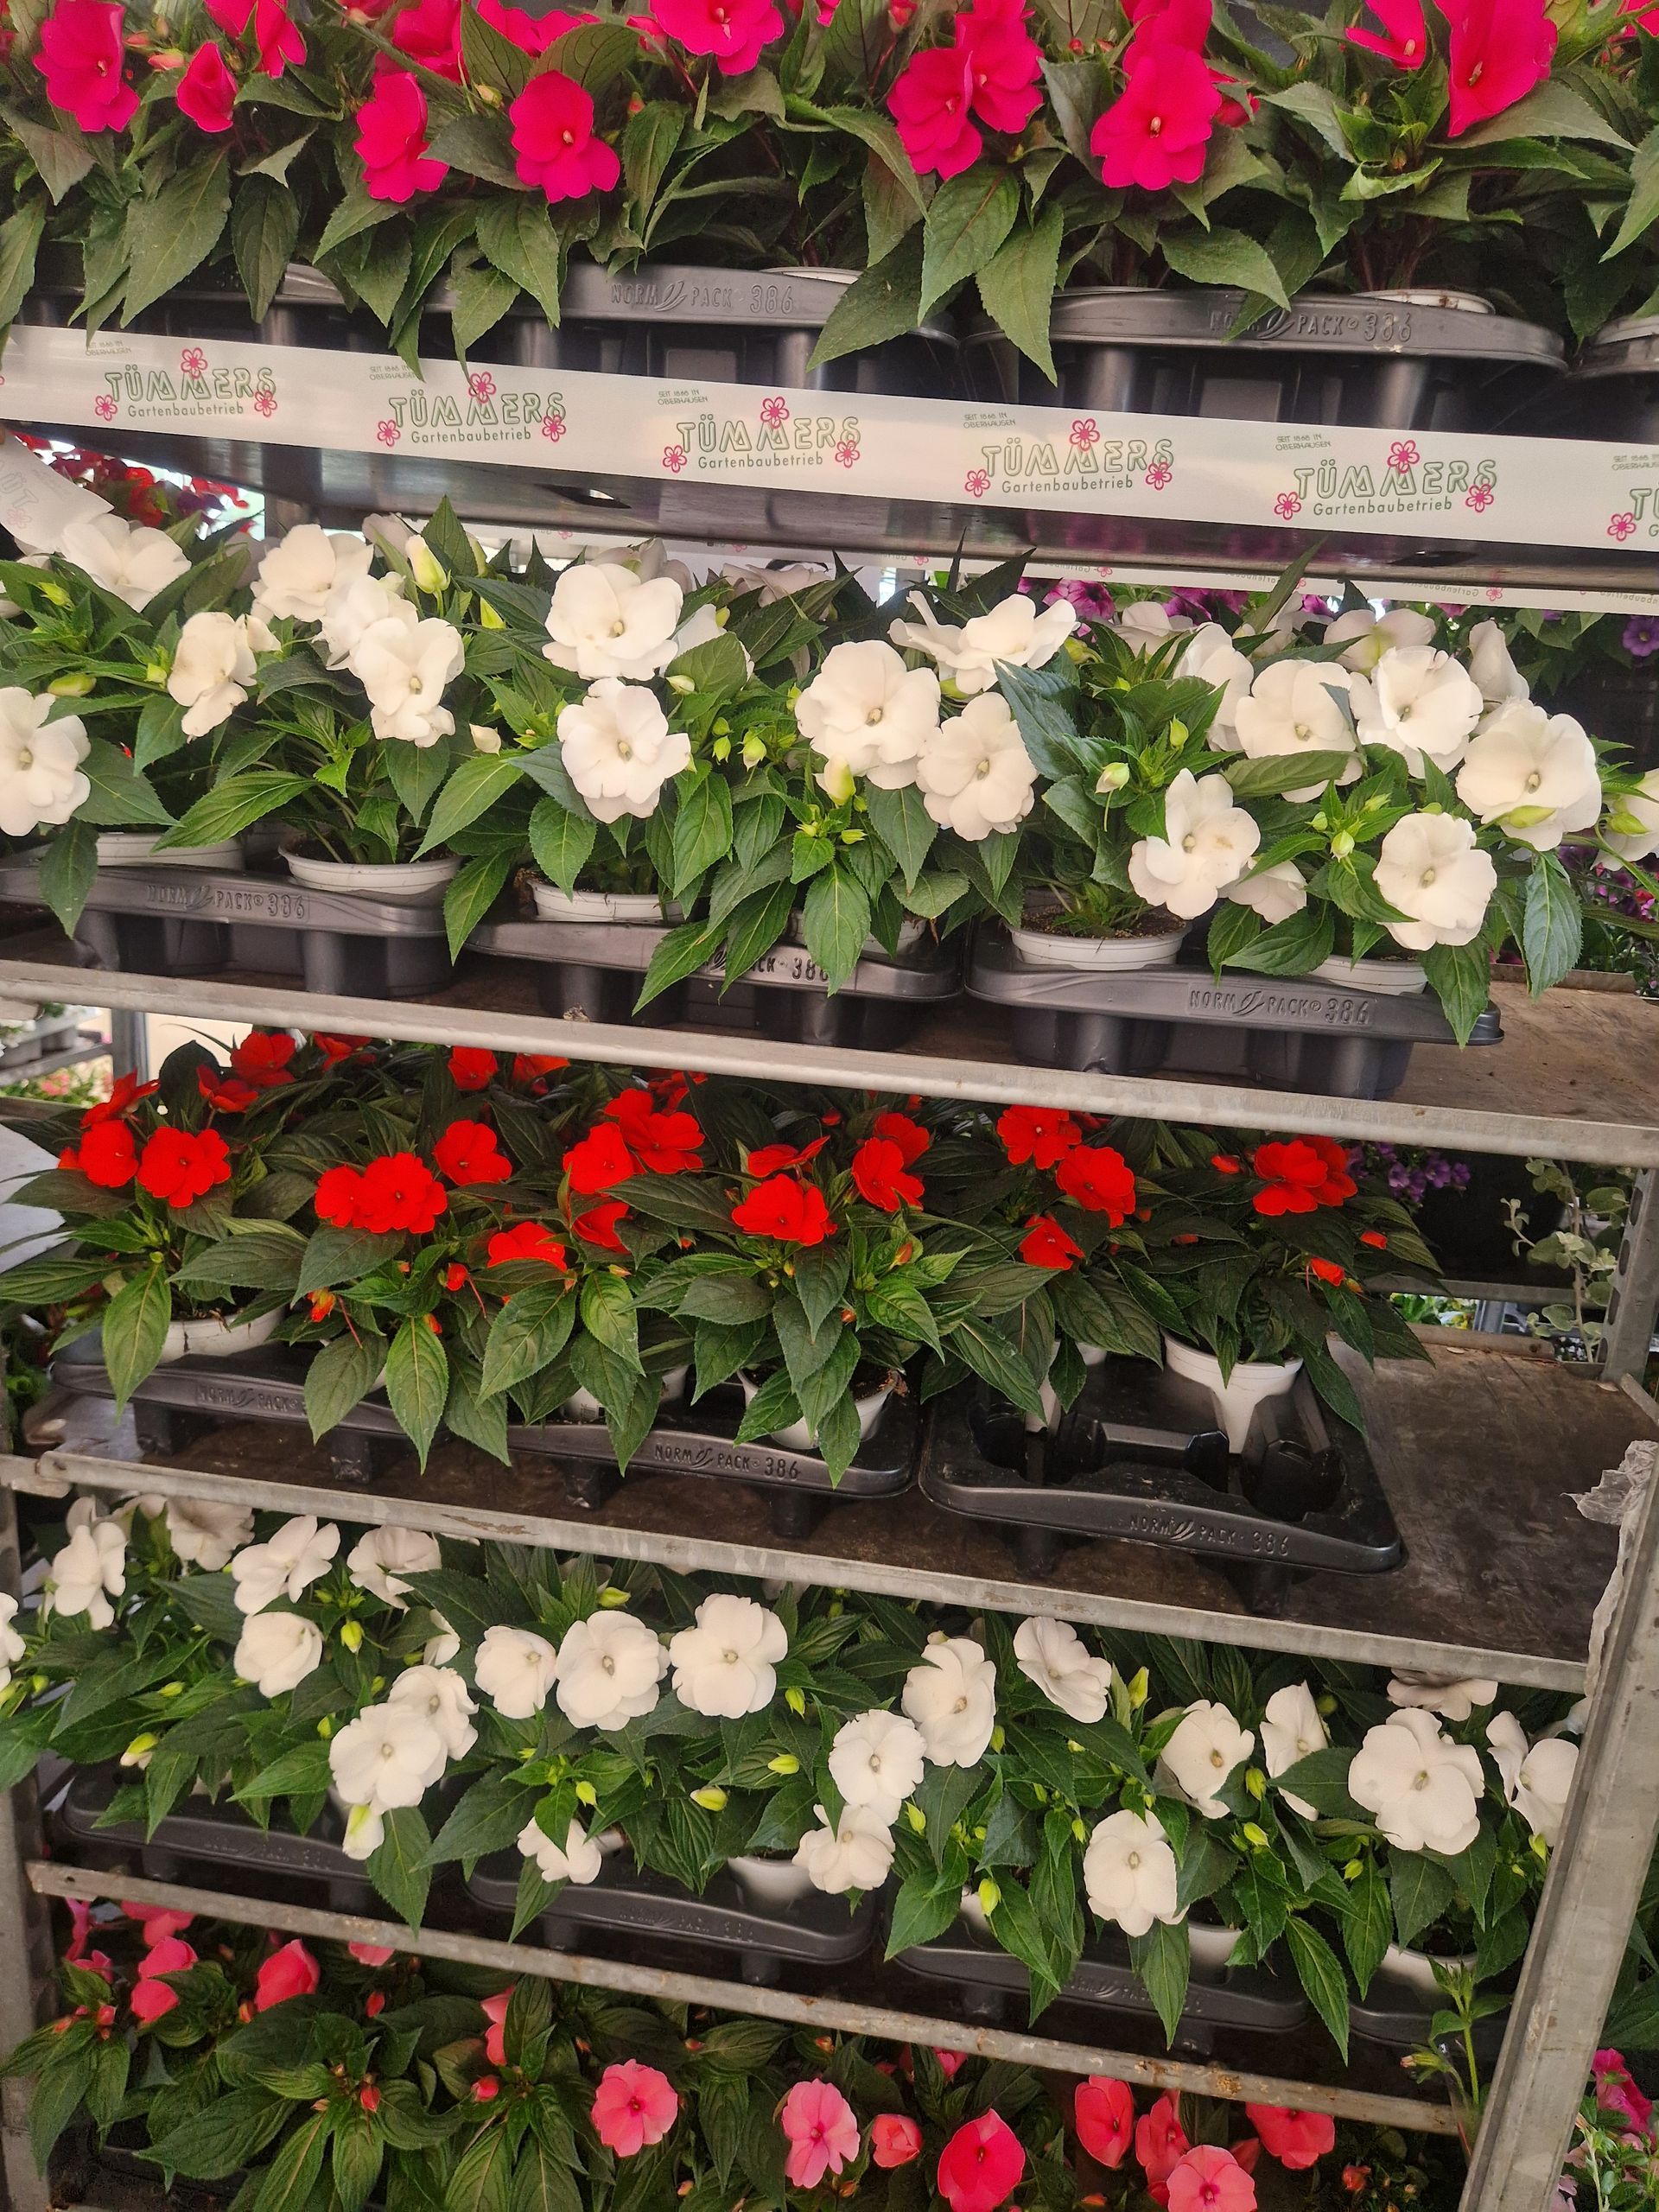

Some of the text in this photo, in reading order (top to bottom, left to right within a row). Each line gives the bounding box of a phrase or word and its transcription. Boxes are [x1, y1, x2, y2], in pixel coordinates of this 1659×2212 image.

[610, 283, 793, 315] NORM PACK 386
[1363, 311, 1412, 342] 386
[105, 365, 276, 402] TÜMMERS
[128, 401, 244, 418] Gartenbaubetrieb
[389, 389, 566, 429] TÜMMERS
[657, 396, 709, 405] OBERHAUSEN
[411, 427, 531, 443] Gartenbaubetrieb
[677, 413, 861, 453] TÜMMERS
[963, 419, 1016, 429] OBERHAUSEN
[698, 451, 823, 469] Gartenbaubetrieb
[982, 437, 1173, 477] TÜMMERS
[1275, 441, 1332, 450] OBERHAUSEN
[1002, 474, 1134, 493] Gartenbaubetrieb
[1294, 459, 1497, 499] TÜMMERS
[1313, 496, 1452, 516] Gartenbaubetrieb
[145, 885, 188, 905] NORM
[268, 892, 305, 918] 386
[1190, 990, 1236, 1011] NORM
[1325, 998, 1370, 1025] 386
[655, 1444, 692, 1465] NORM
[764, 1457, 799, 1481] 386
[1129, 1515, 1289, 1556] NORM PACK 386
